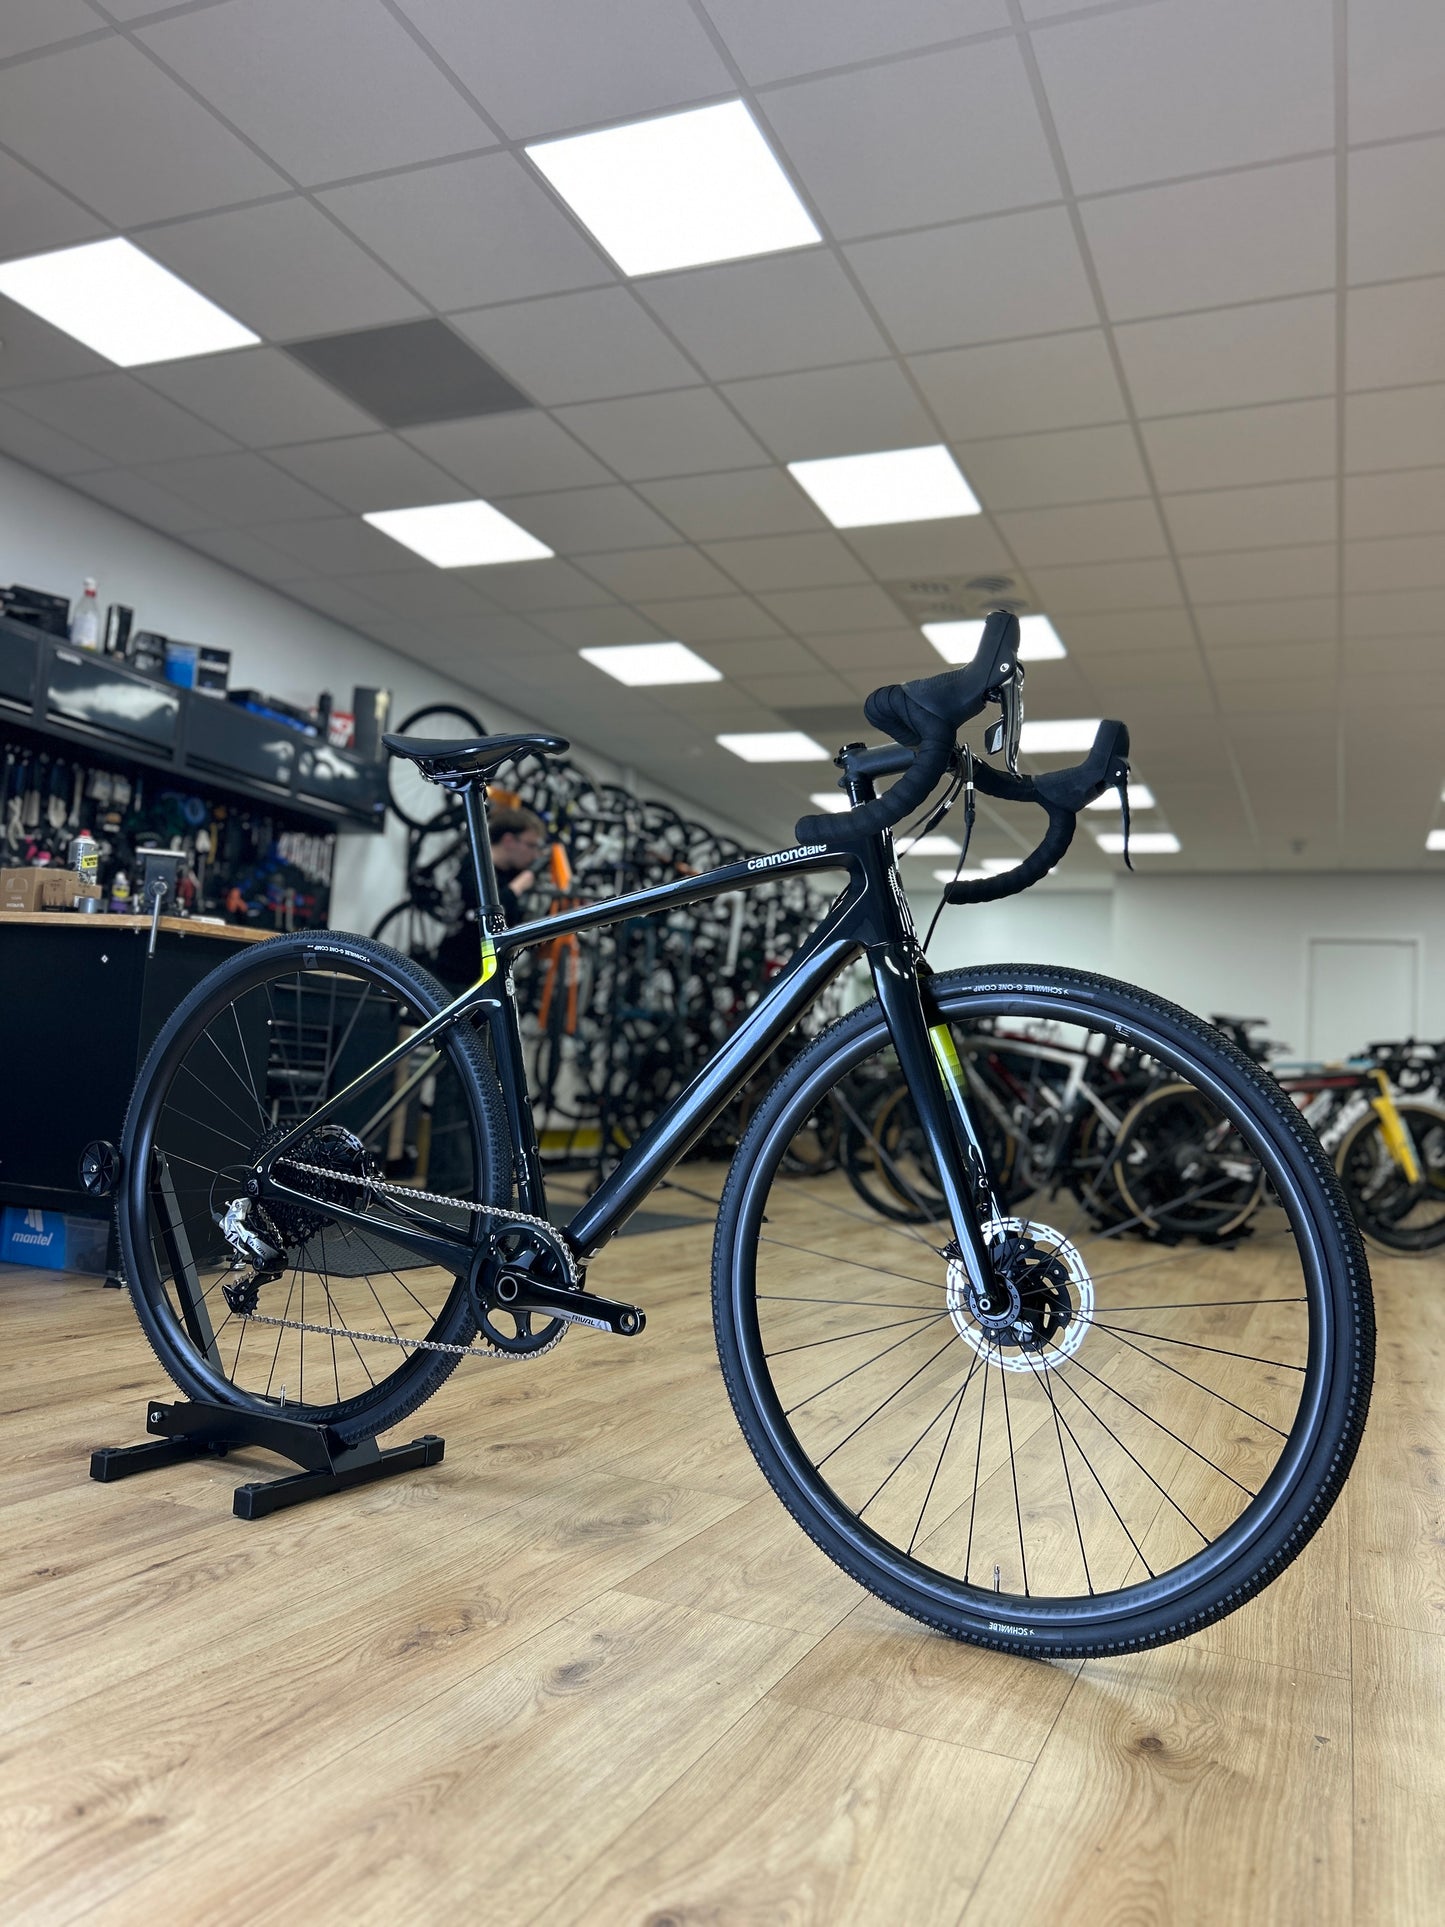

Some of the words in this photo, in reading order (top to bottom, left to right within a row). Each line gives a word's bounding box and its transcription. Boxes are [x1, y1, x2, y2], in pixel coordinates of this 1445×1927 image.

[747, 844, 827, 870] cannondale
[973, 984, 997, 992] COMP
[998, 983, 1023, 991] G-ONE
[1024, 984, 1063, 995] SCHWALBE
[12, 1232, 54, 1246] mantel
[571, 1314, 595, 1326] RIVAL
[988, 1621, 1028, 1636] SCHWALBE
